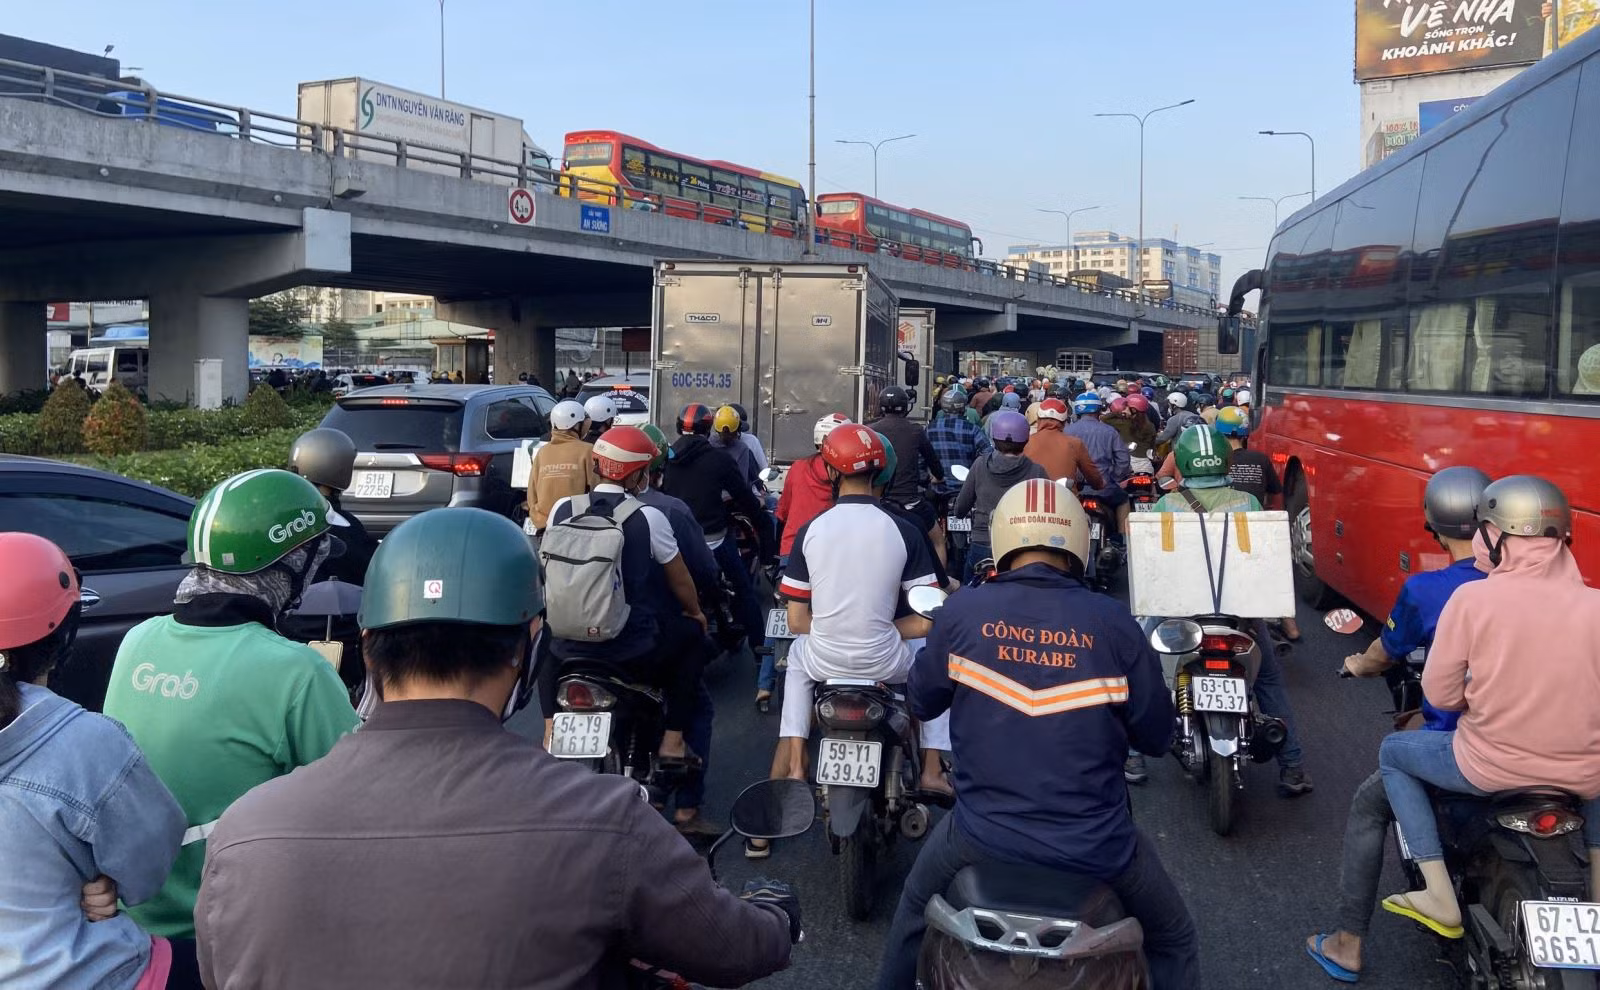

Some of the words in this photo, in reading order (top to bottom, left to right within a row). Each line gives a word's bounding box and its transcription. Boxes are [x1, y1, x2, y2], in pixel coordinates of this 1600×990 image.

[1424, 27, 1453, 39] SỐNG
[1455, 25, 1484, 36] TRỌN
[1382, 41, 1455, 60] KHOẢNH
[1458, 30, 1517, 51] KHẮC!
[376, 91, 397, 110] DNTN
[1192, 455, 1222, 467] Grab
[366, 473, 385, 484] 51H
[357, 484, 390, 496] 727.56
[268, 510, 316, 544] Grab
[1047, 516, 1072, 527] KURABE
[981, 620, 1035, 643] CÔNG
[1040, 628, 1094, 649] ĐOÀN
[997, 645, 1077, 669] KURABE
[132, 662, 199, 700] Grab
[1201, 679, 1237, 694] 63-C1
[1197, 694, 1244, 710] 475.37
[561, 715, 602, 734] 54-Y9
[559, 735, 599, 753] 1613
[829, 742, 870, 762] 59-Y1
[821, 762, 876, 783] 439.43
[1536, 906, 1600, 933] 67-L2
